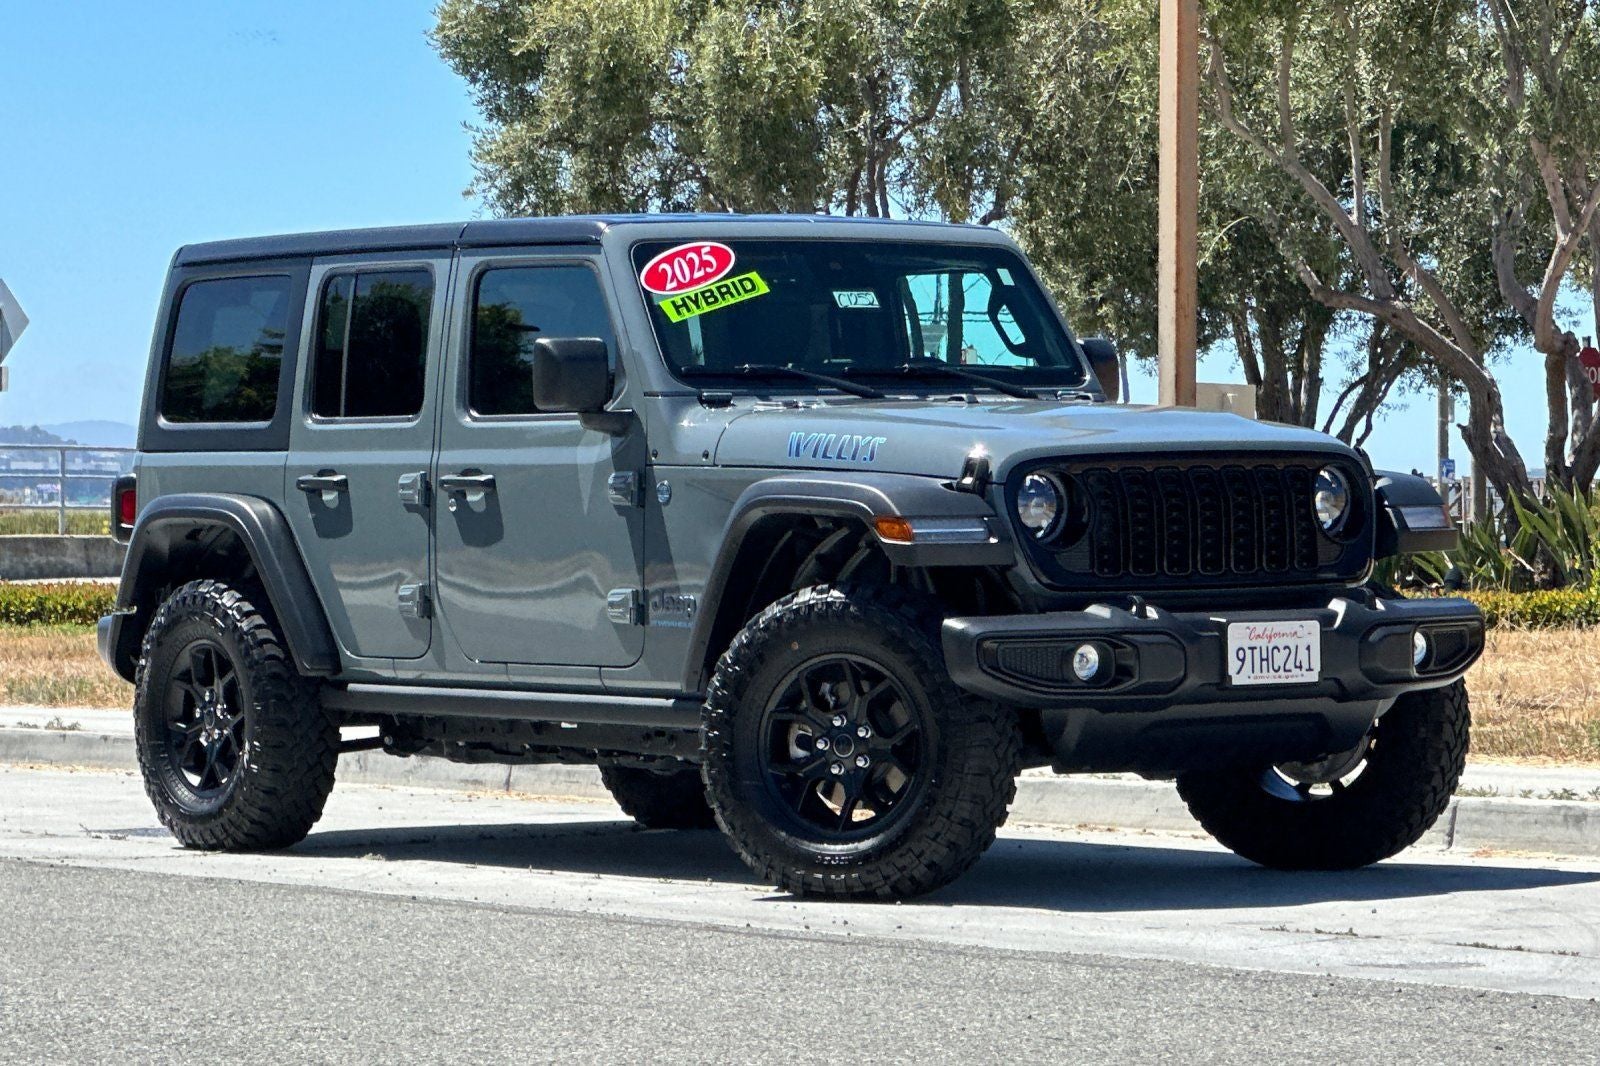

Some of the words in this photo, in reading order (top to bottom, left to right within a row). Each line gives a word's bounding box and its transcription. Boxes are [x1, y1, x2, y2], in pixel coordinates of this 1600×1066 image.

[658, 246, 717, 290] 2025
[671, 276, 758, 316] HYBRID
[788, 431, 887, 461] WILLYS
[1249, 626, 1302, 643] California
[1235, 644, 1314, 675] 9THC241
